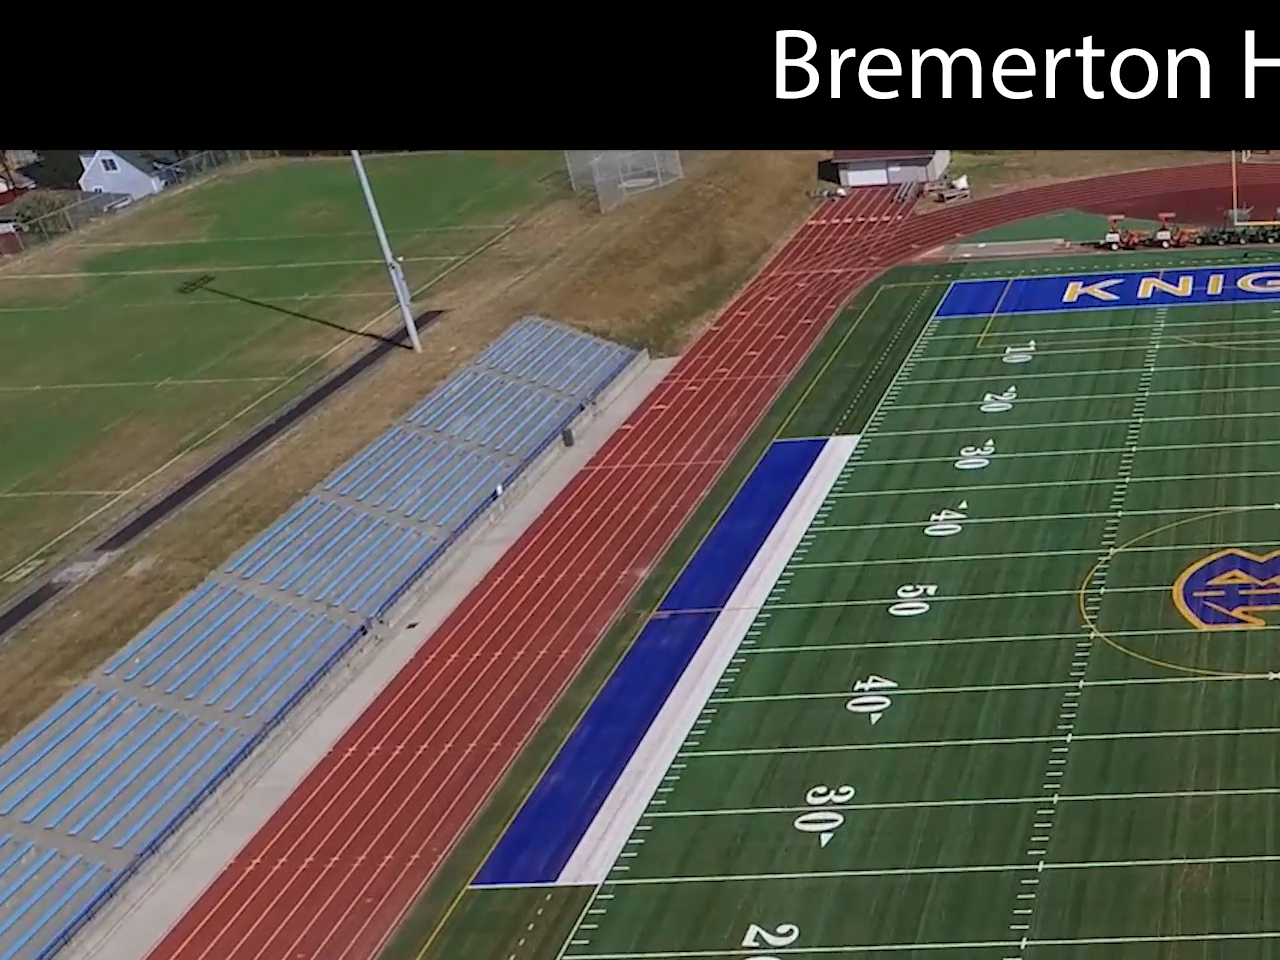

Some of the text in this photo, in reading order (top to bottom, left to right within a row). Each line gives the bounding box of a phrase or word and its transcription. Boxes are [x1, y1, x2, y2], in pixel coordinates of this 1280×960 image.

[1002, 346, 1036, 363] 10
[980, 391, 1017, 413] 20
[954, 446, 995, 469] 30
[924, 509, 968, 536] 40
[888, 585, 938, 616] 50
[845, 675, 898, 712] 40
[794, 786, 855, 831] 30
